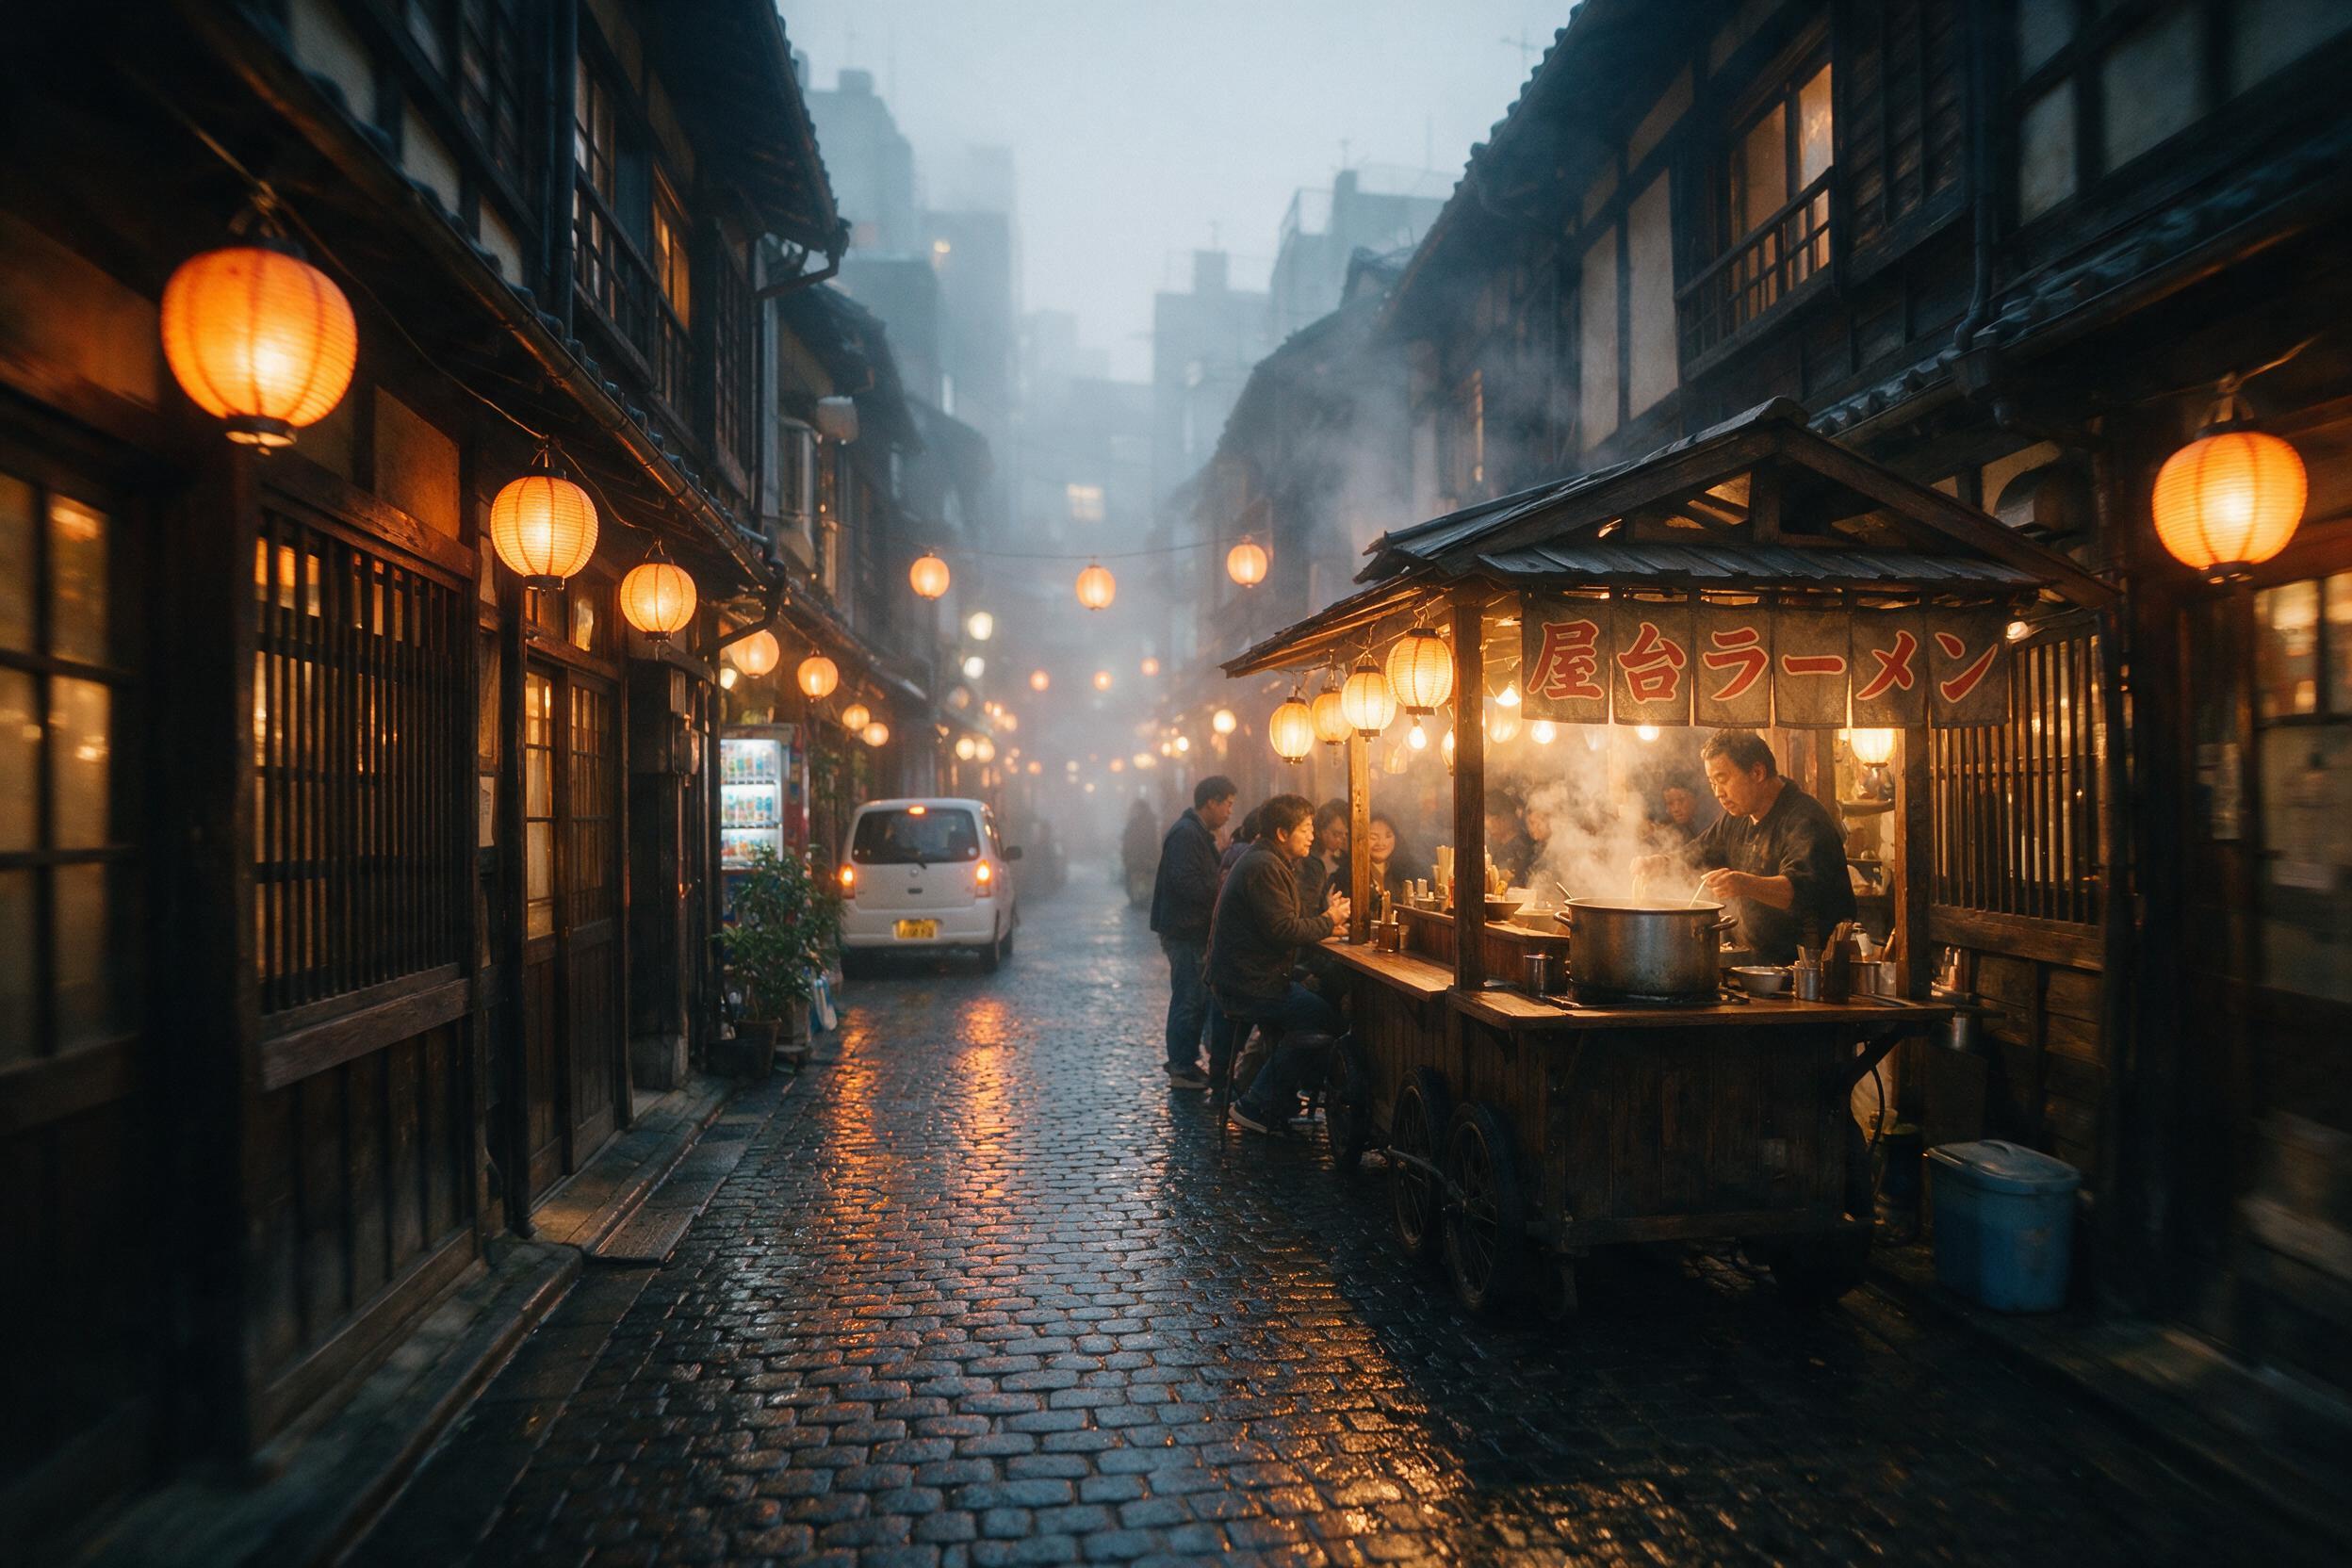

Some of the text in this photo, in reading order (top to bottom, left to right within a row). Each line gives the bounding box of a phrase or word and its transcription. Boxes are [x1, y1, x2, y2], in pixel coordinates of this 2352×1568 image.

[1527, 618, 1999, 704] 屋台ラーメン
